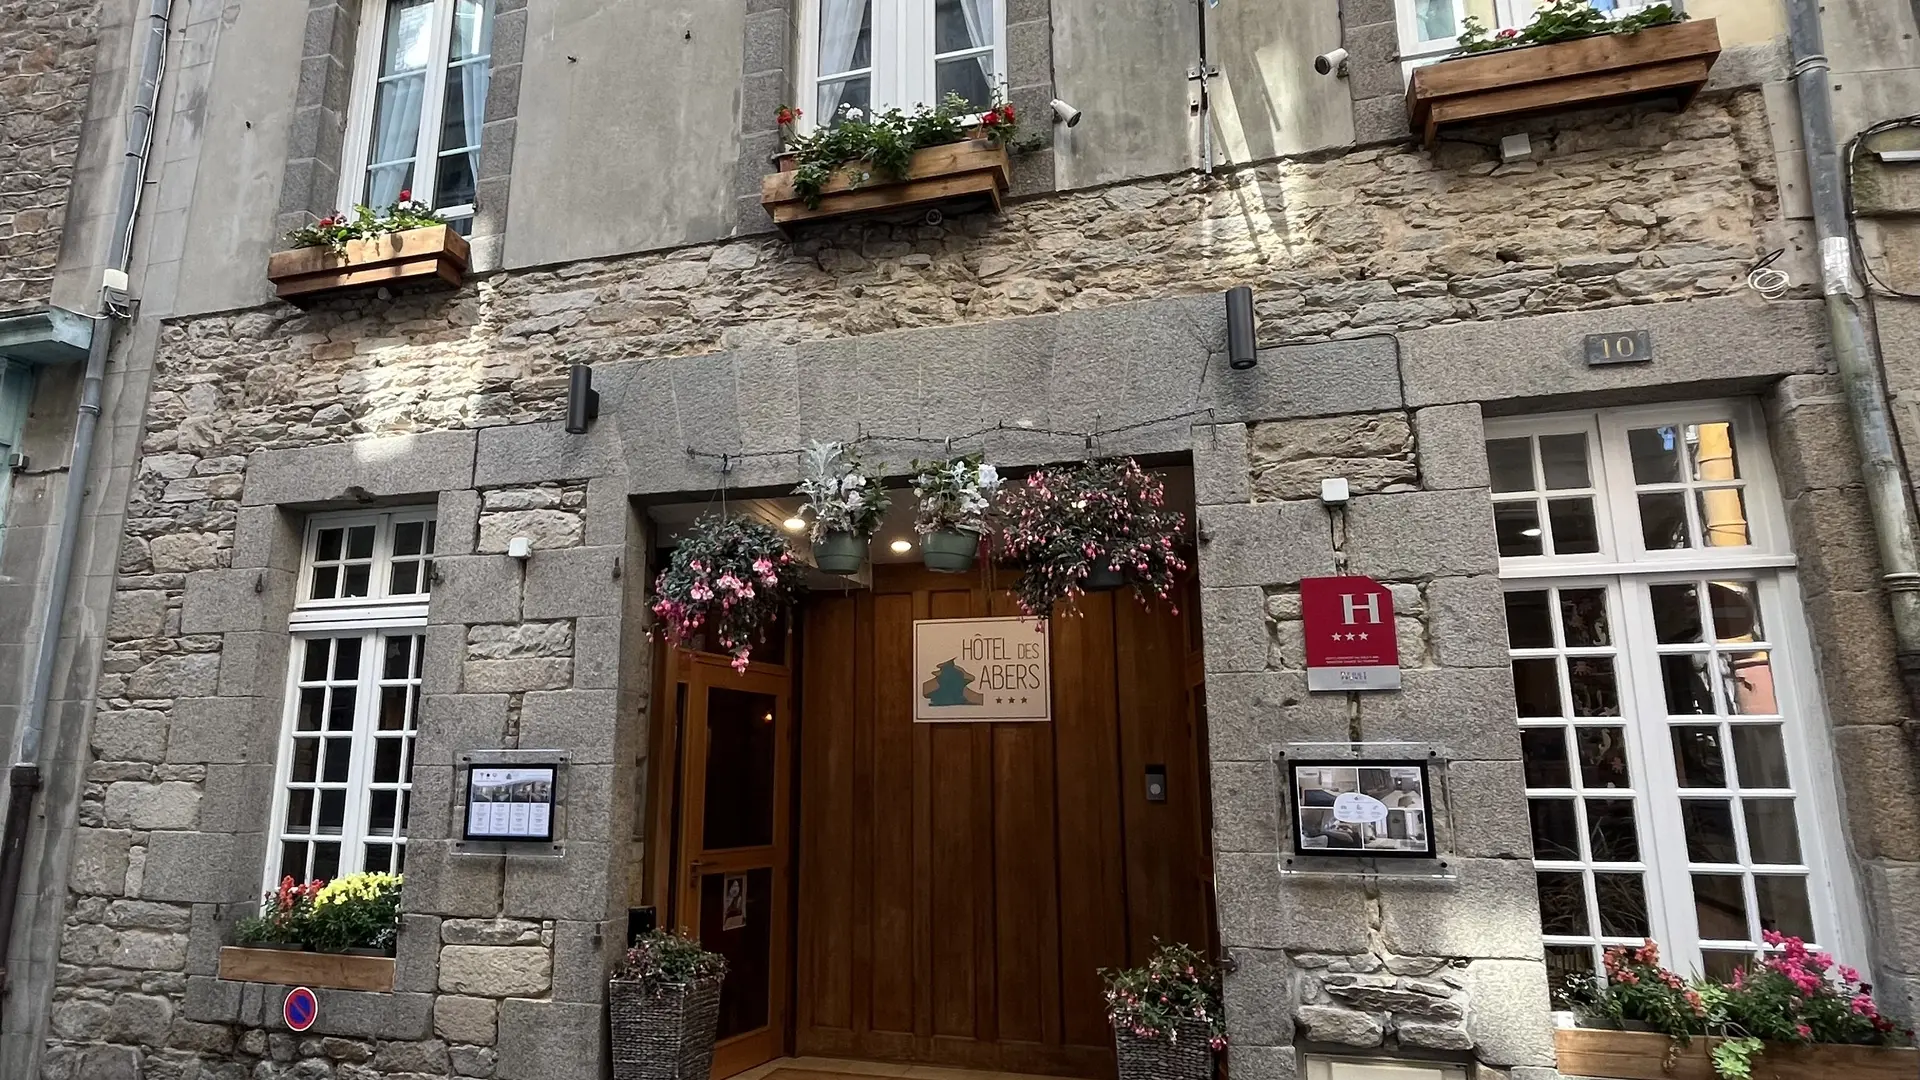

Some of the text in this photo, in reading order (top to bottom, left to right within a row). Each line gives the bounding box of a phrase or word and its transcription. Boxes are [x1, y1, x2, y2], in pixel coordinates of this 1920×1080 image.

[1602, 337, 1635, 359] 10
[1339, 593, 1384, 625] H
[962, 633, 1040, 660] HÔTEL DES
[979, 664, 1041, 690] ABERS
